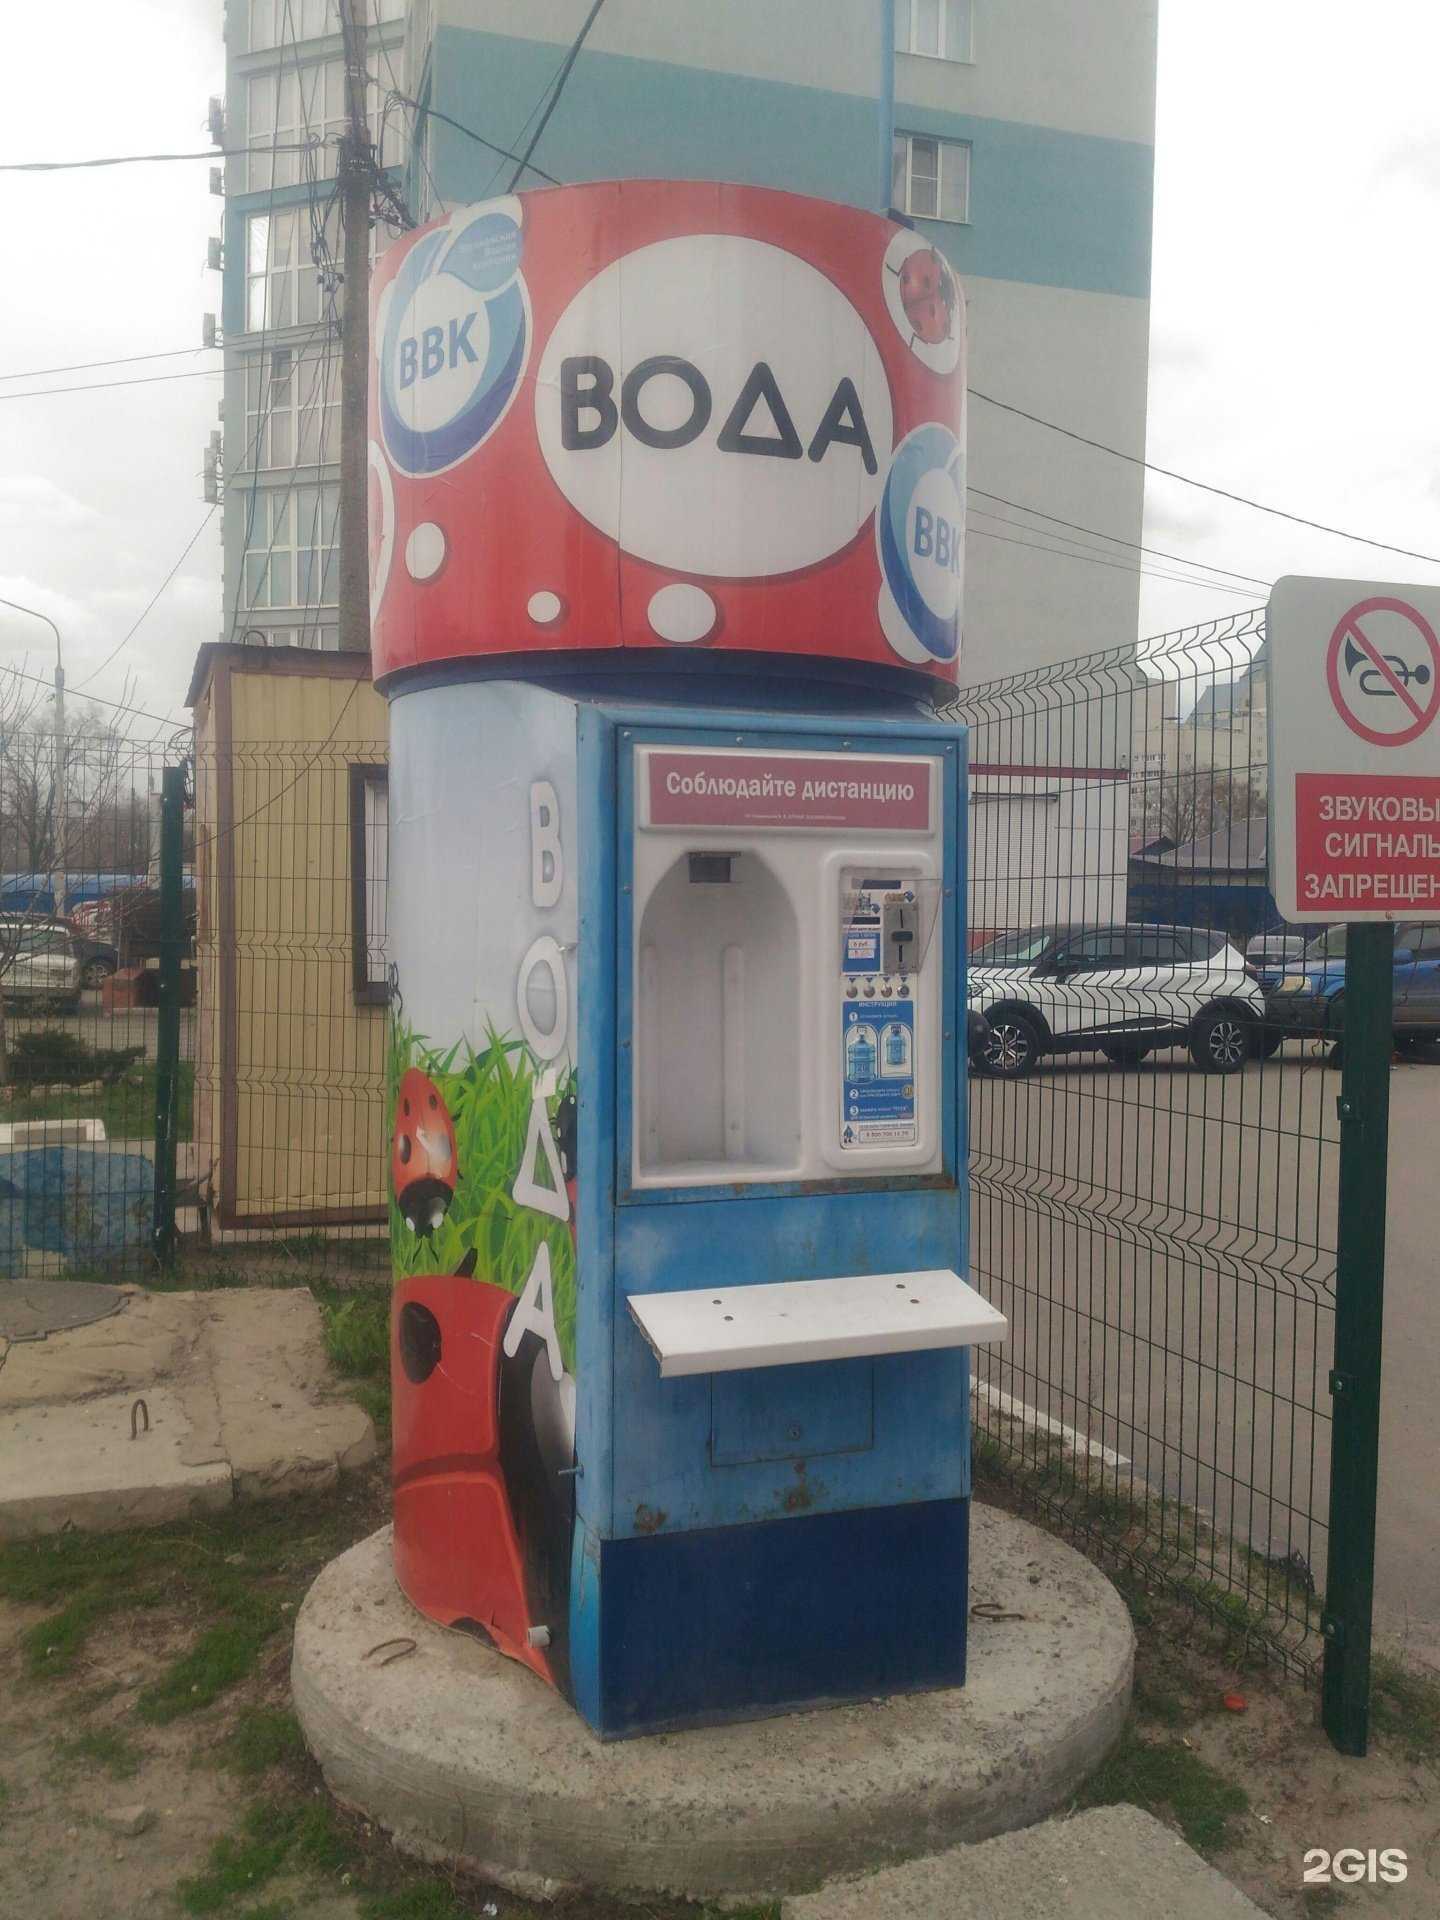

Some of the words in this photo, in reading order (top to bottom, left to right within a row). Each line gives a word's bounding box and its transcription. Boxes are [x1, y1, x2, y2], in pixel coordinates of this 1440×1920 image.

[399, 311, 480, 391] ВВК
[560, 355, 879, 476] ВОДА
[666, 771, 796, 799] Соблюдайте
[802, 780, 914, 803] дистанцию
[503, 780, 570, 1381] ВОДА
